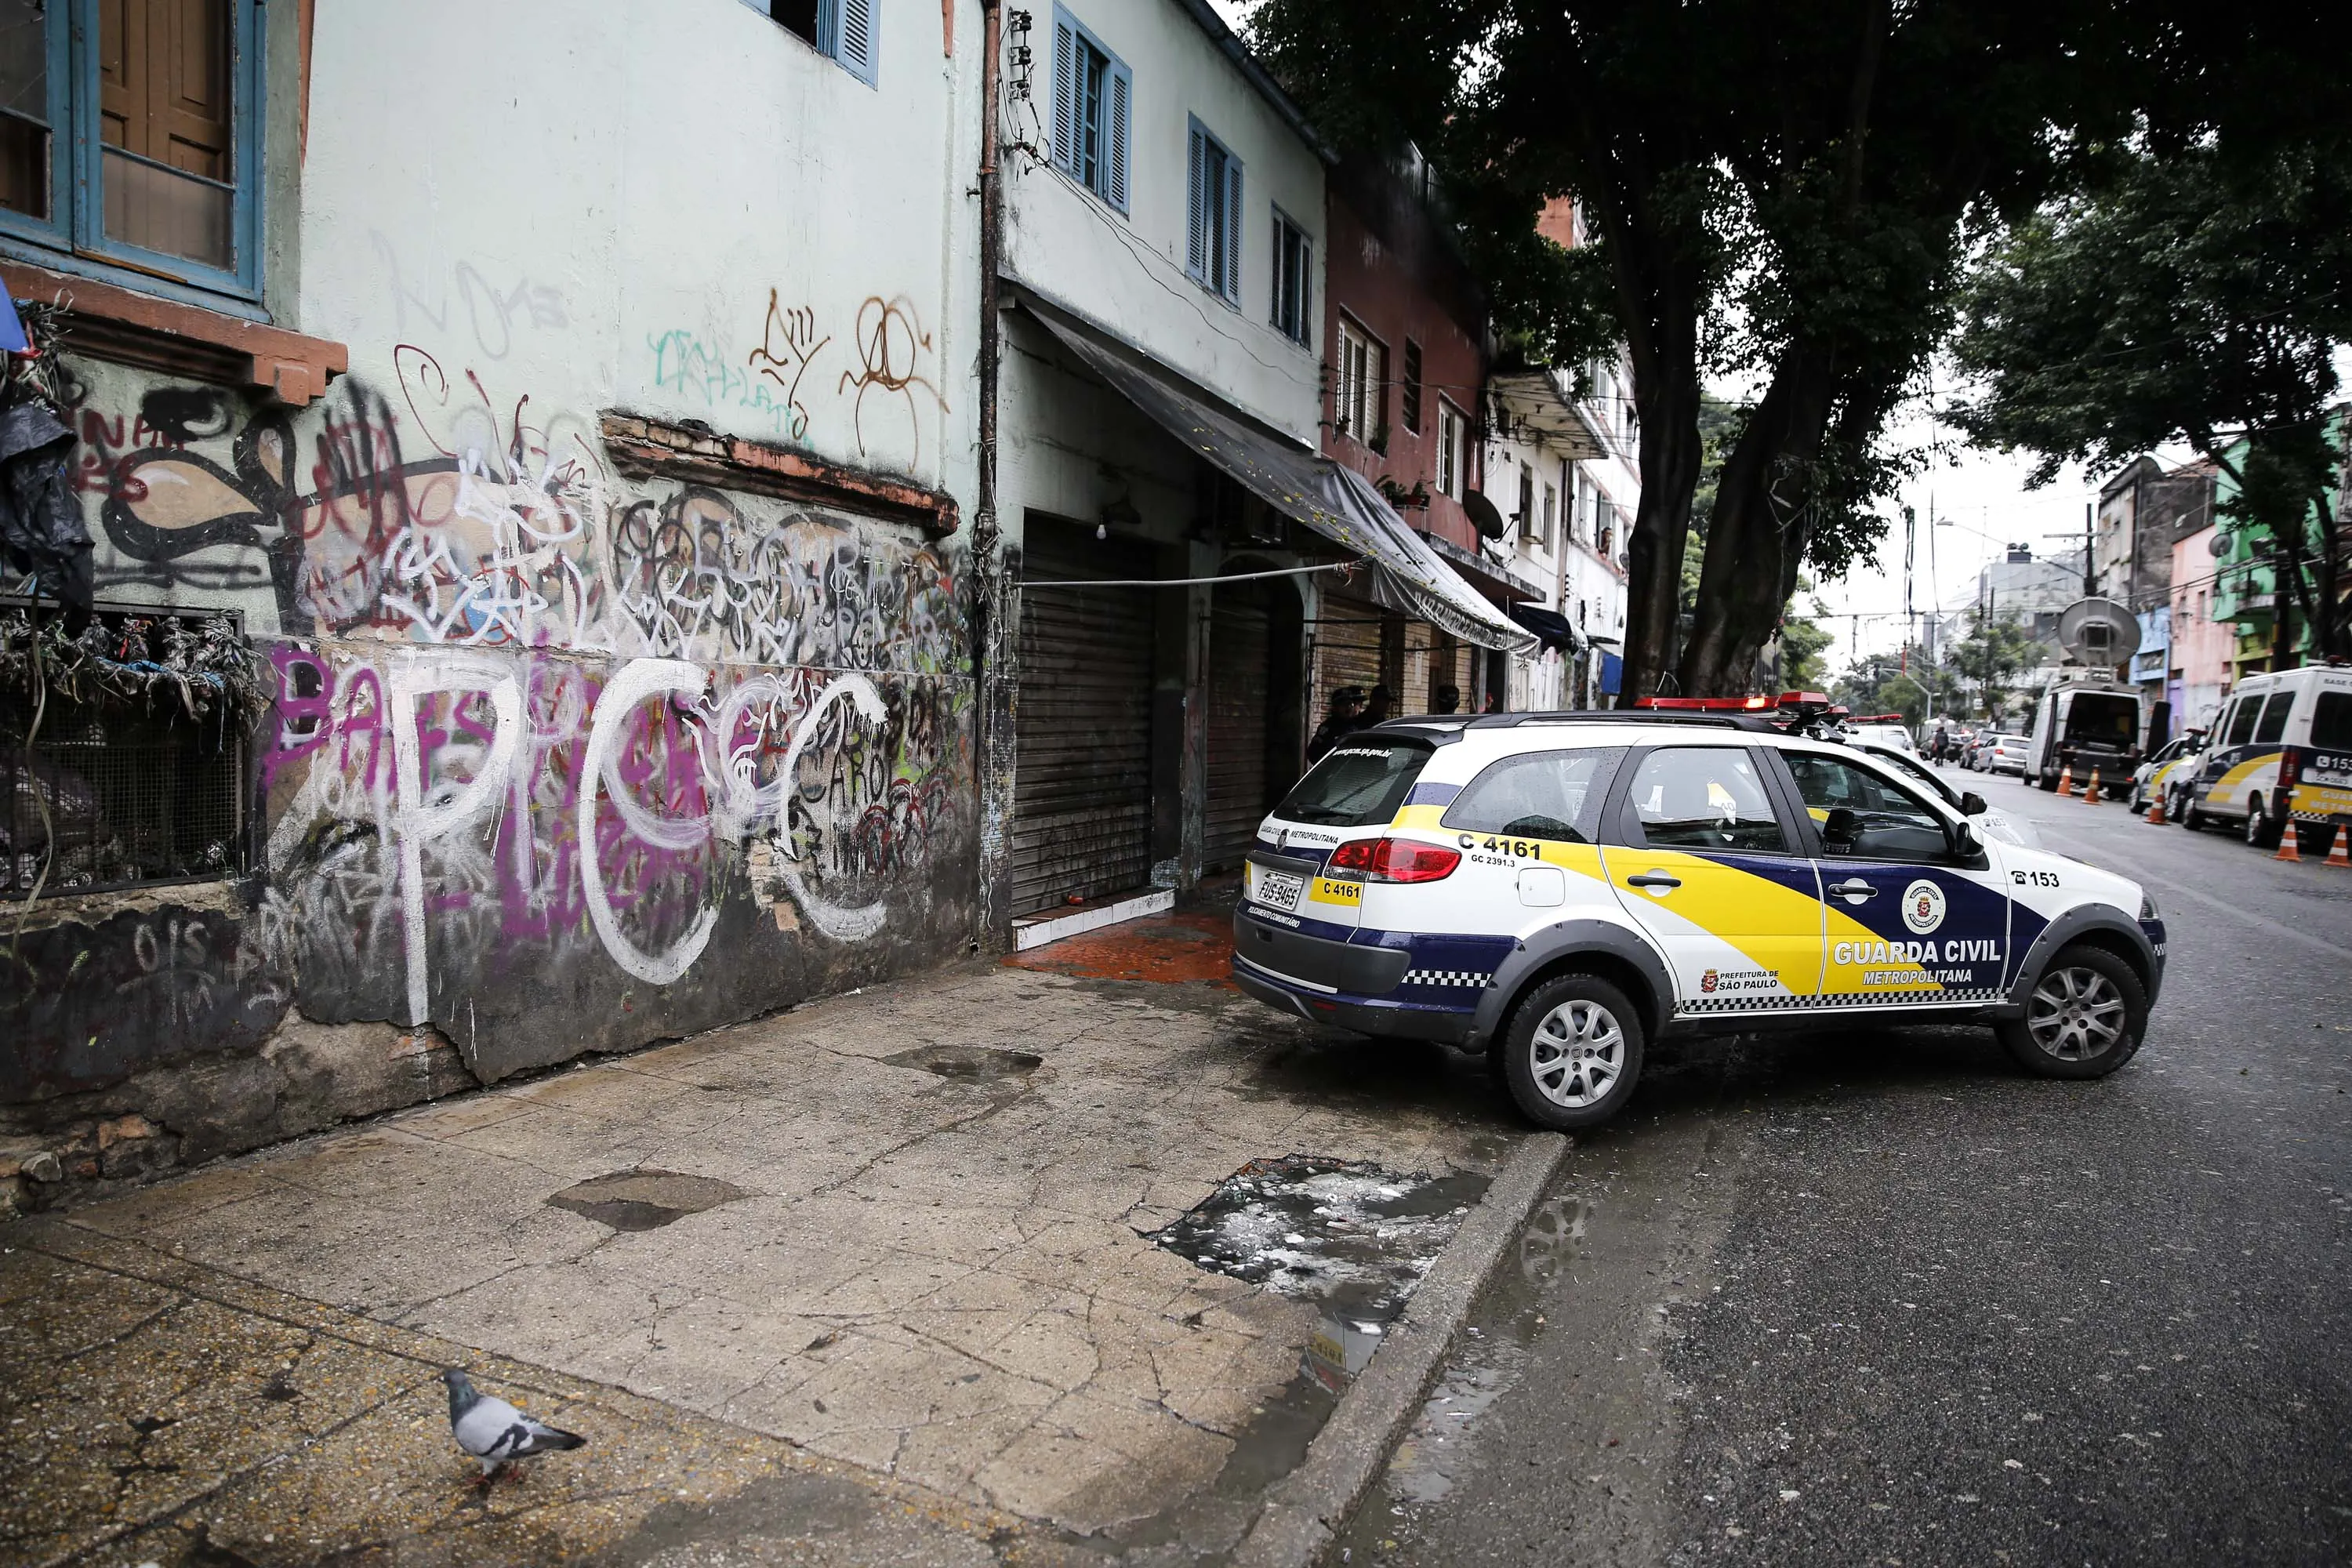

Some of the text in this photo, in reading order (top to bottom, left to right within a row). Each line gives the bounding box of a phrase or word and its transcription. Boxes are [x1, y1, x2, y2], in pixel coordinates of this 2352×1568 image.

[1290, 830, 1339, 844] METROPOLITANA
[1457, 833, 1541, 860] C 4161
[1471, 854, 1515, 868] GC 2391.3
[2030, 871, 2060, 887] 153
[1323, 882, 1359, 898] C 4161
[1911, 887, 1938, 900] GUARDA CIVIL
[1247, 906, 1301, 928] POLICIAMENTO COMUNITÁRIO
[1909, 914, 1937, 927] METROPOLITANA
[1833, 939, 2002, 965] GUARDA CIVIL
[1719, 979, 1777, 990] SÃO PAULO
[1862, 969, 1973, 985] METROPOLITANA
